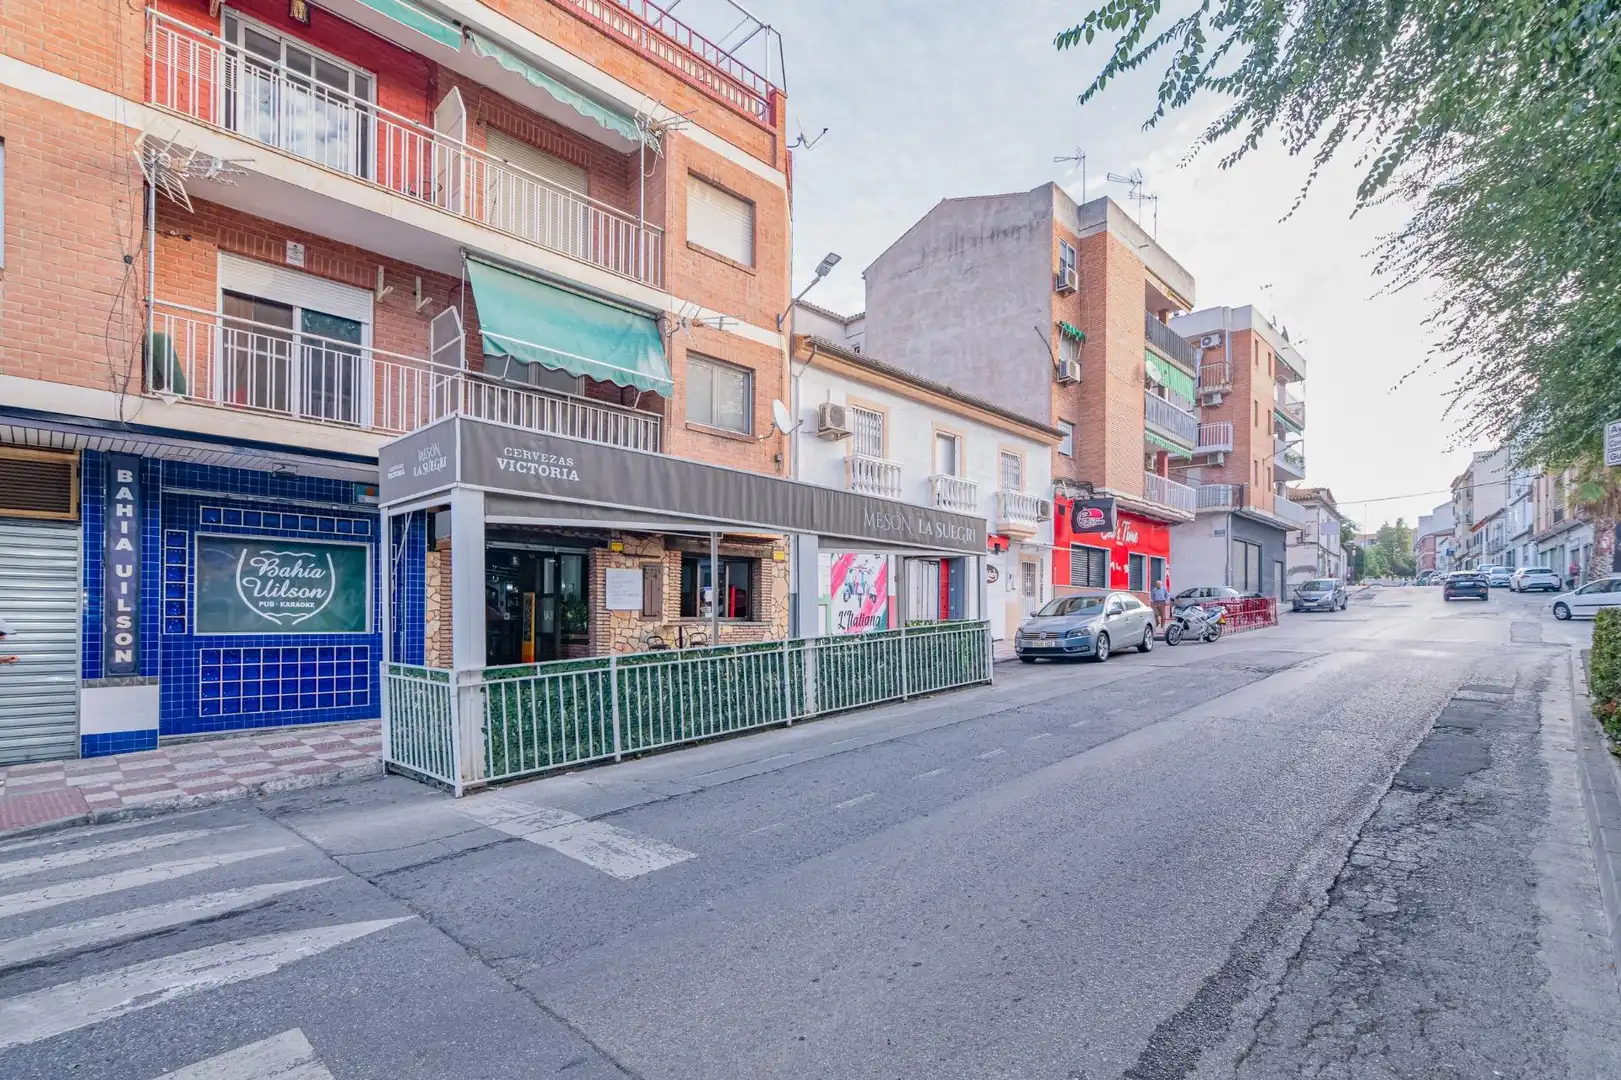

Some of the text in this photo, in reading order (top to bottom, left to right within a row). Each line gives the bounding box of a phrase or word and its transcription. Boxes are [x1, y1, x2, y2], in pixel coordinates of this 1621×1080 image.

[496, 457, 580, 481] VICTORIA
[504, 447, 574, 467] CERVEZAS
[862, 507, 914, 535] MESÓN
[919, 518, 933, 536] LA
[114, 469, 134, 663] BAHIA UILSON
[250, 557, 326, 578] Bahía
